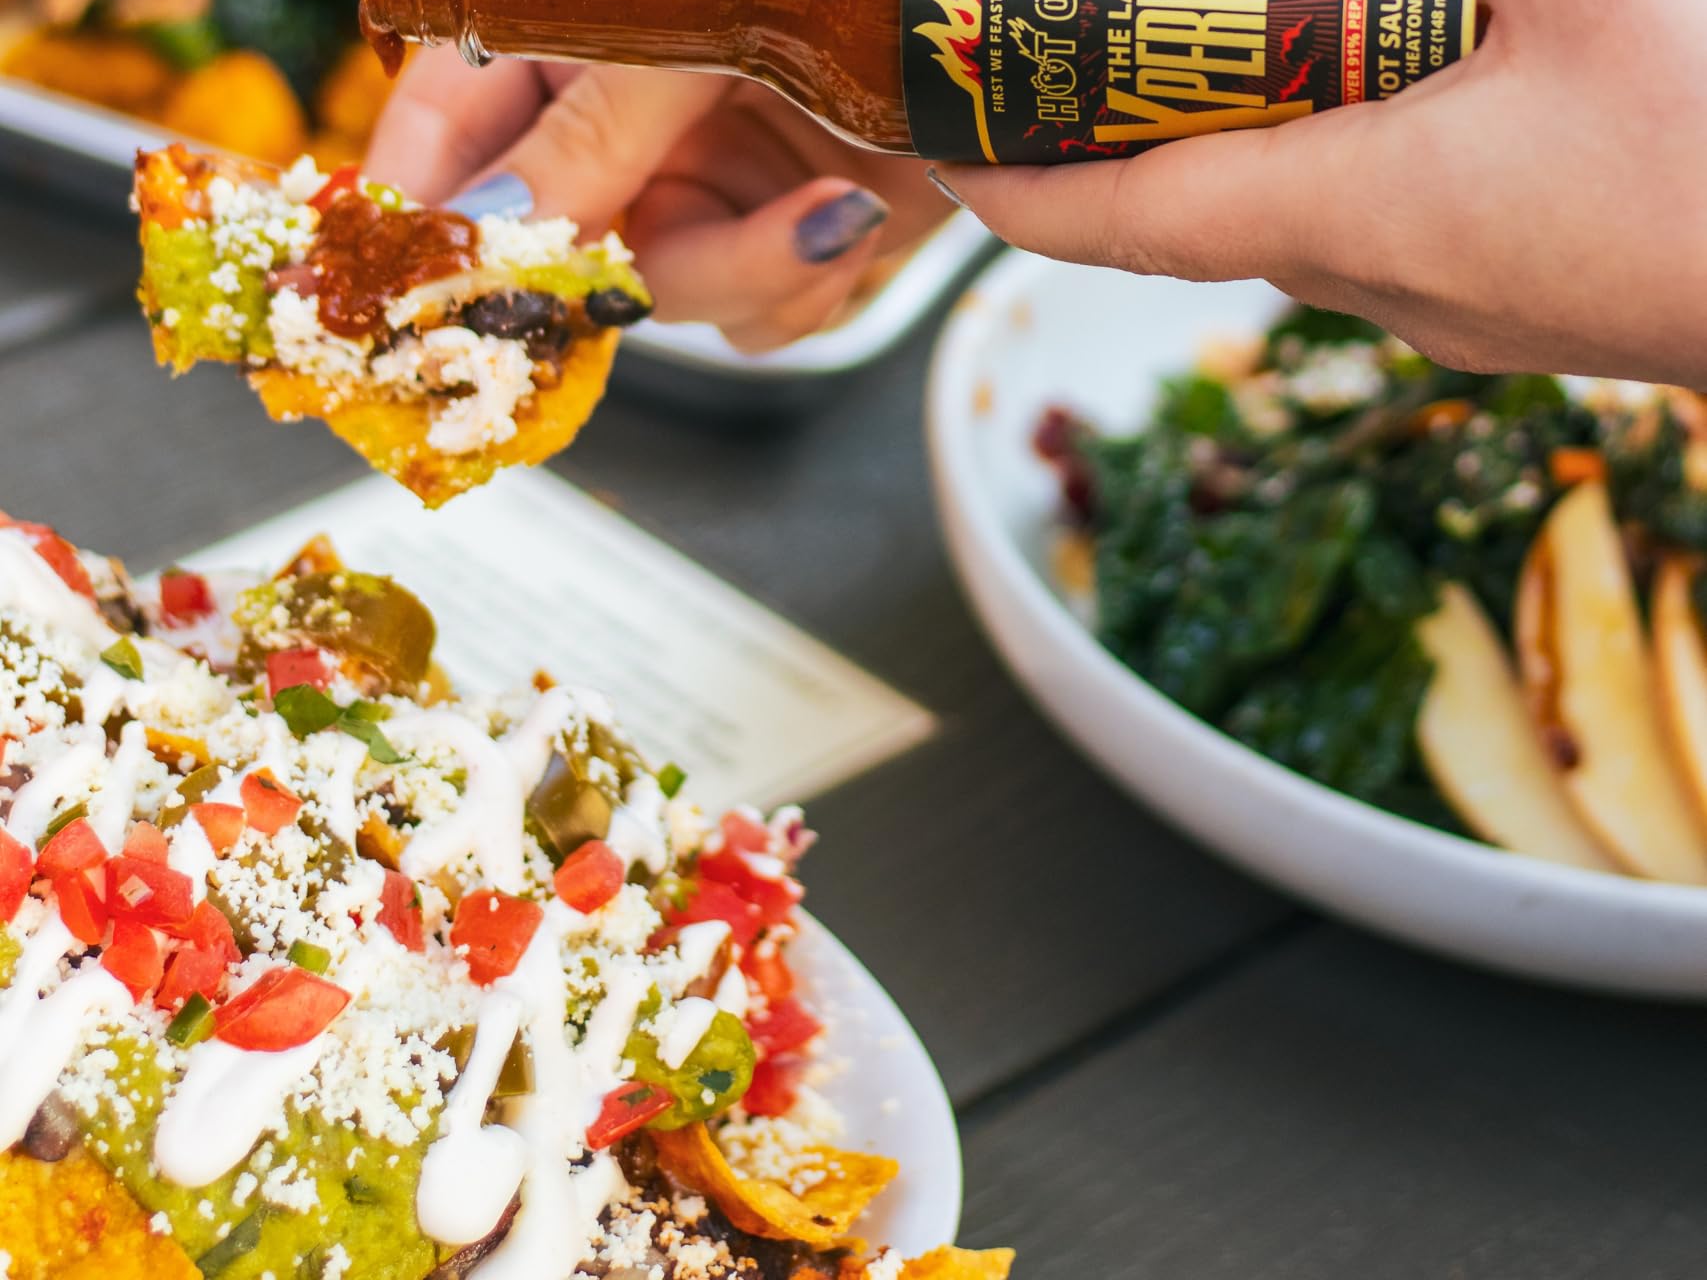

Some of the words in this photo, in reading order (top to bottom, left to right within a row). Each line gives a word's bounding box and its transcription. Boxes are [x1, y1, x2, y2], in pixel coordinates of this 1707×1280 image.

[1430, 9, 1448, 43] (148
[990, 48, 1003, 71] WE
[1106, 28, 1132, 83] THE
[1346, 32, 1361, 66] 91%
[1430, 45, 1444, 67] OZ
[1034, 32, 1079, 121] HOT
[990, 76, 1006, 113] FIRST
